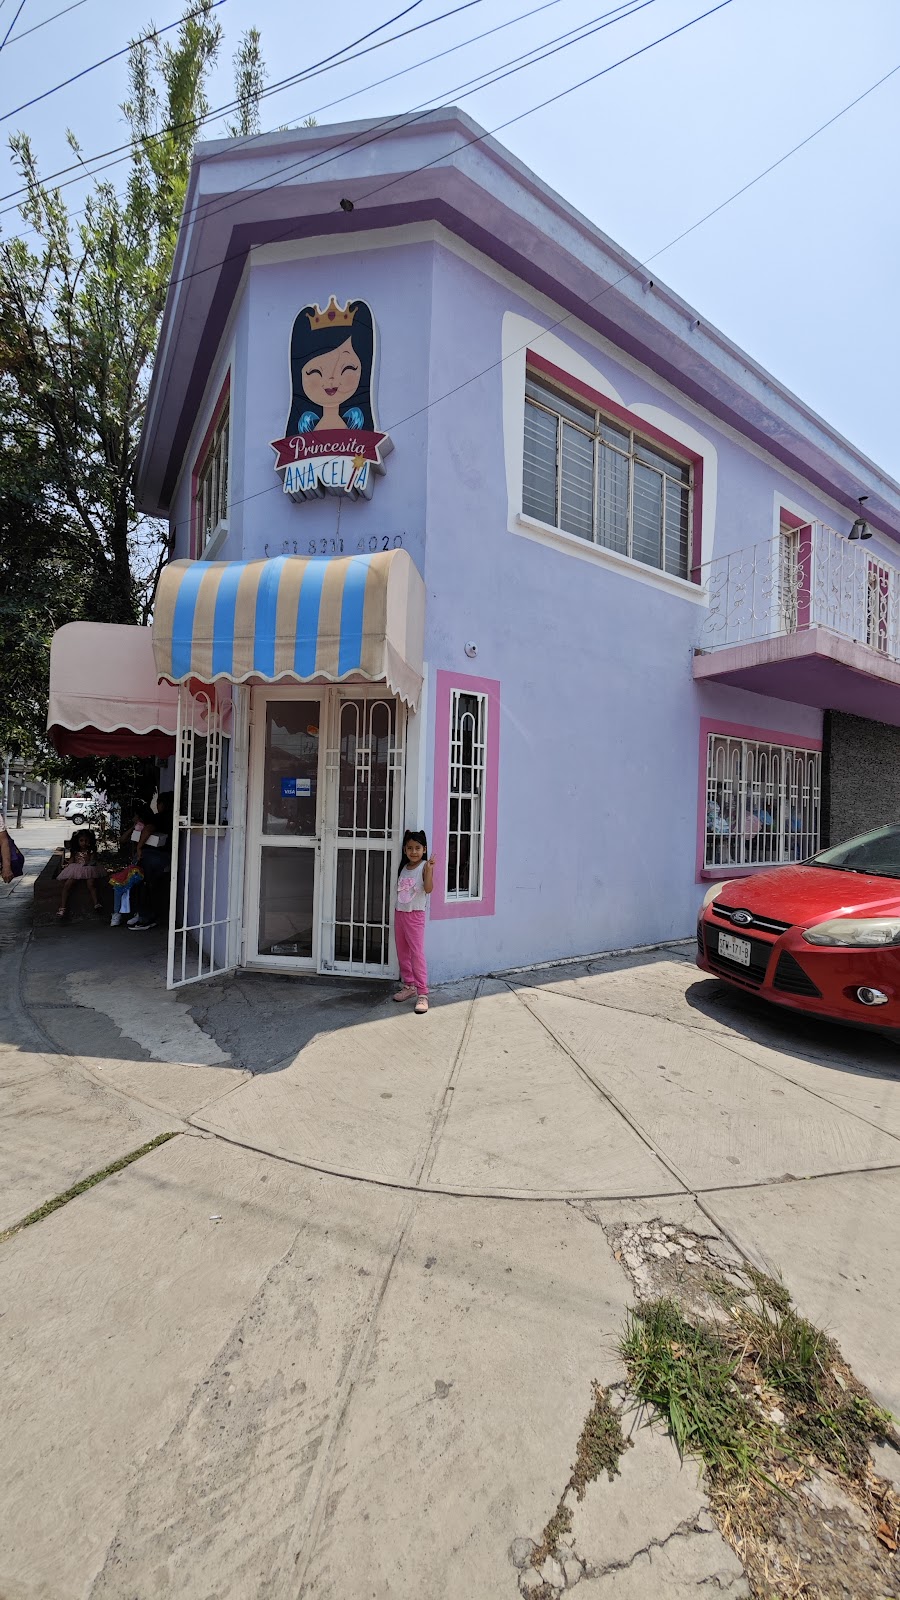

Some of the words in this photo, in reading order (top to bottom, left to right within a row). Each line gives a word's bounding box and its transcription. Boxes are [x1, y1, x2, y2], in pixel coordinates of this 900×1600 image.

[289, 436, 366, 459] Princesita
[286, 462, 315, 491] ANA
[357, 535, 403, 552] 4020
